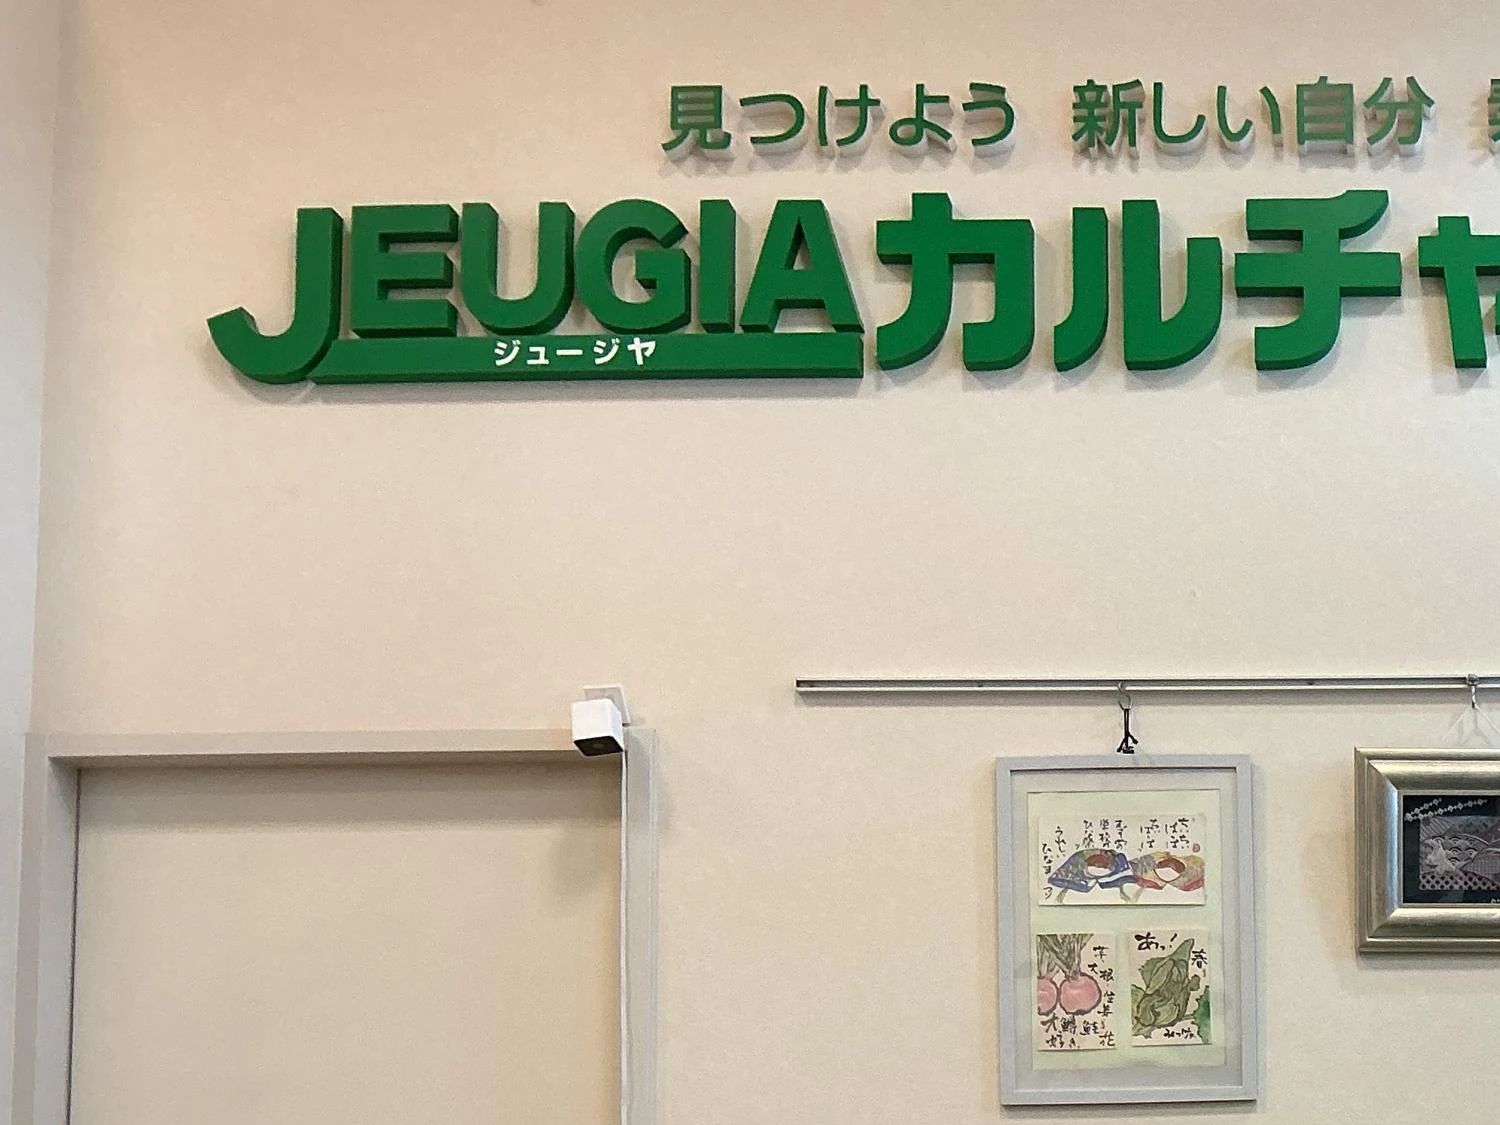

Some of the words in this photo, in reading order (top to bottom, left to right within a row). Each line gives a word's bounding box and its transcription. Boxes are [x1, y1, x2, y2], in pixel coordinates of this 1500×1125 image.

[662, 83, 1016, 152] 見つけよう
[1072, 76, 1436, 148] 新しい自分
